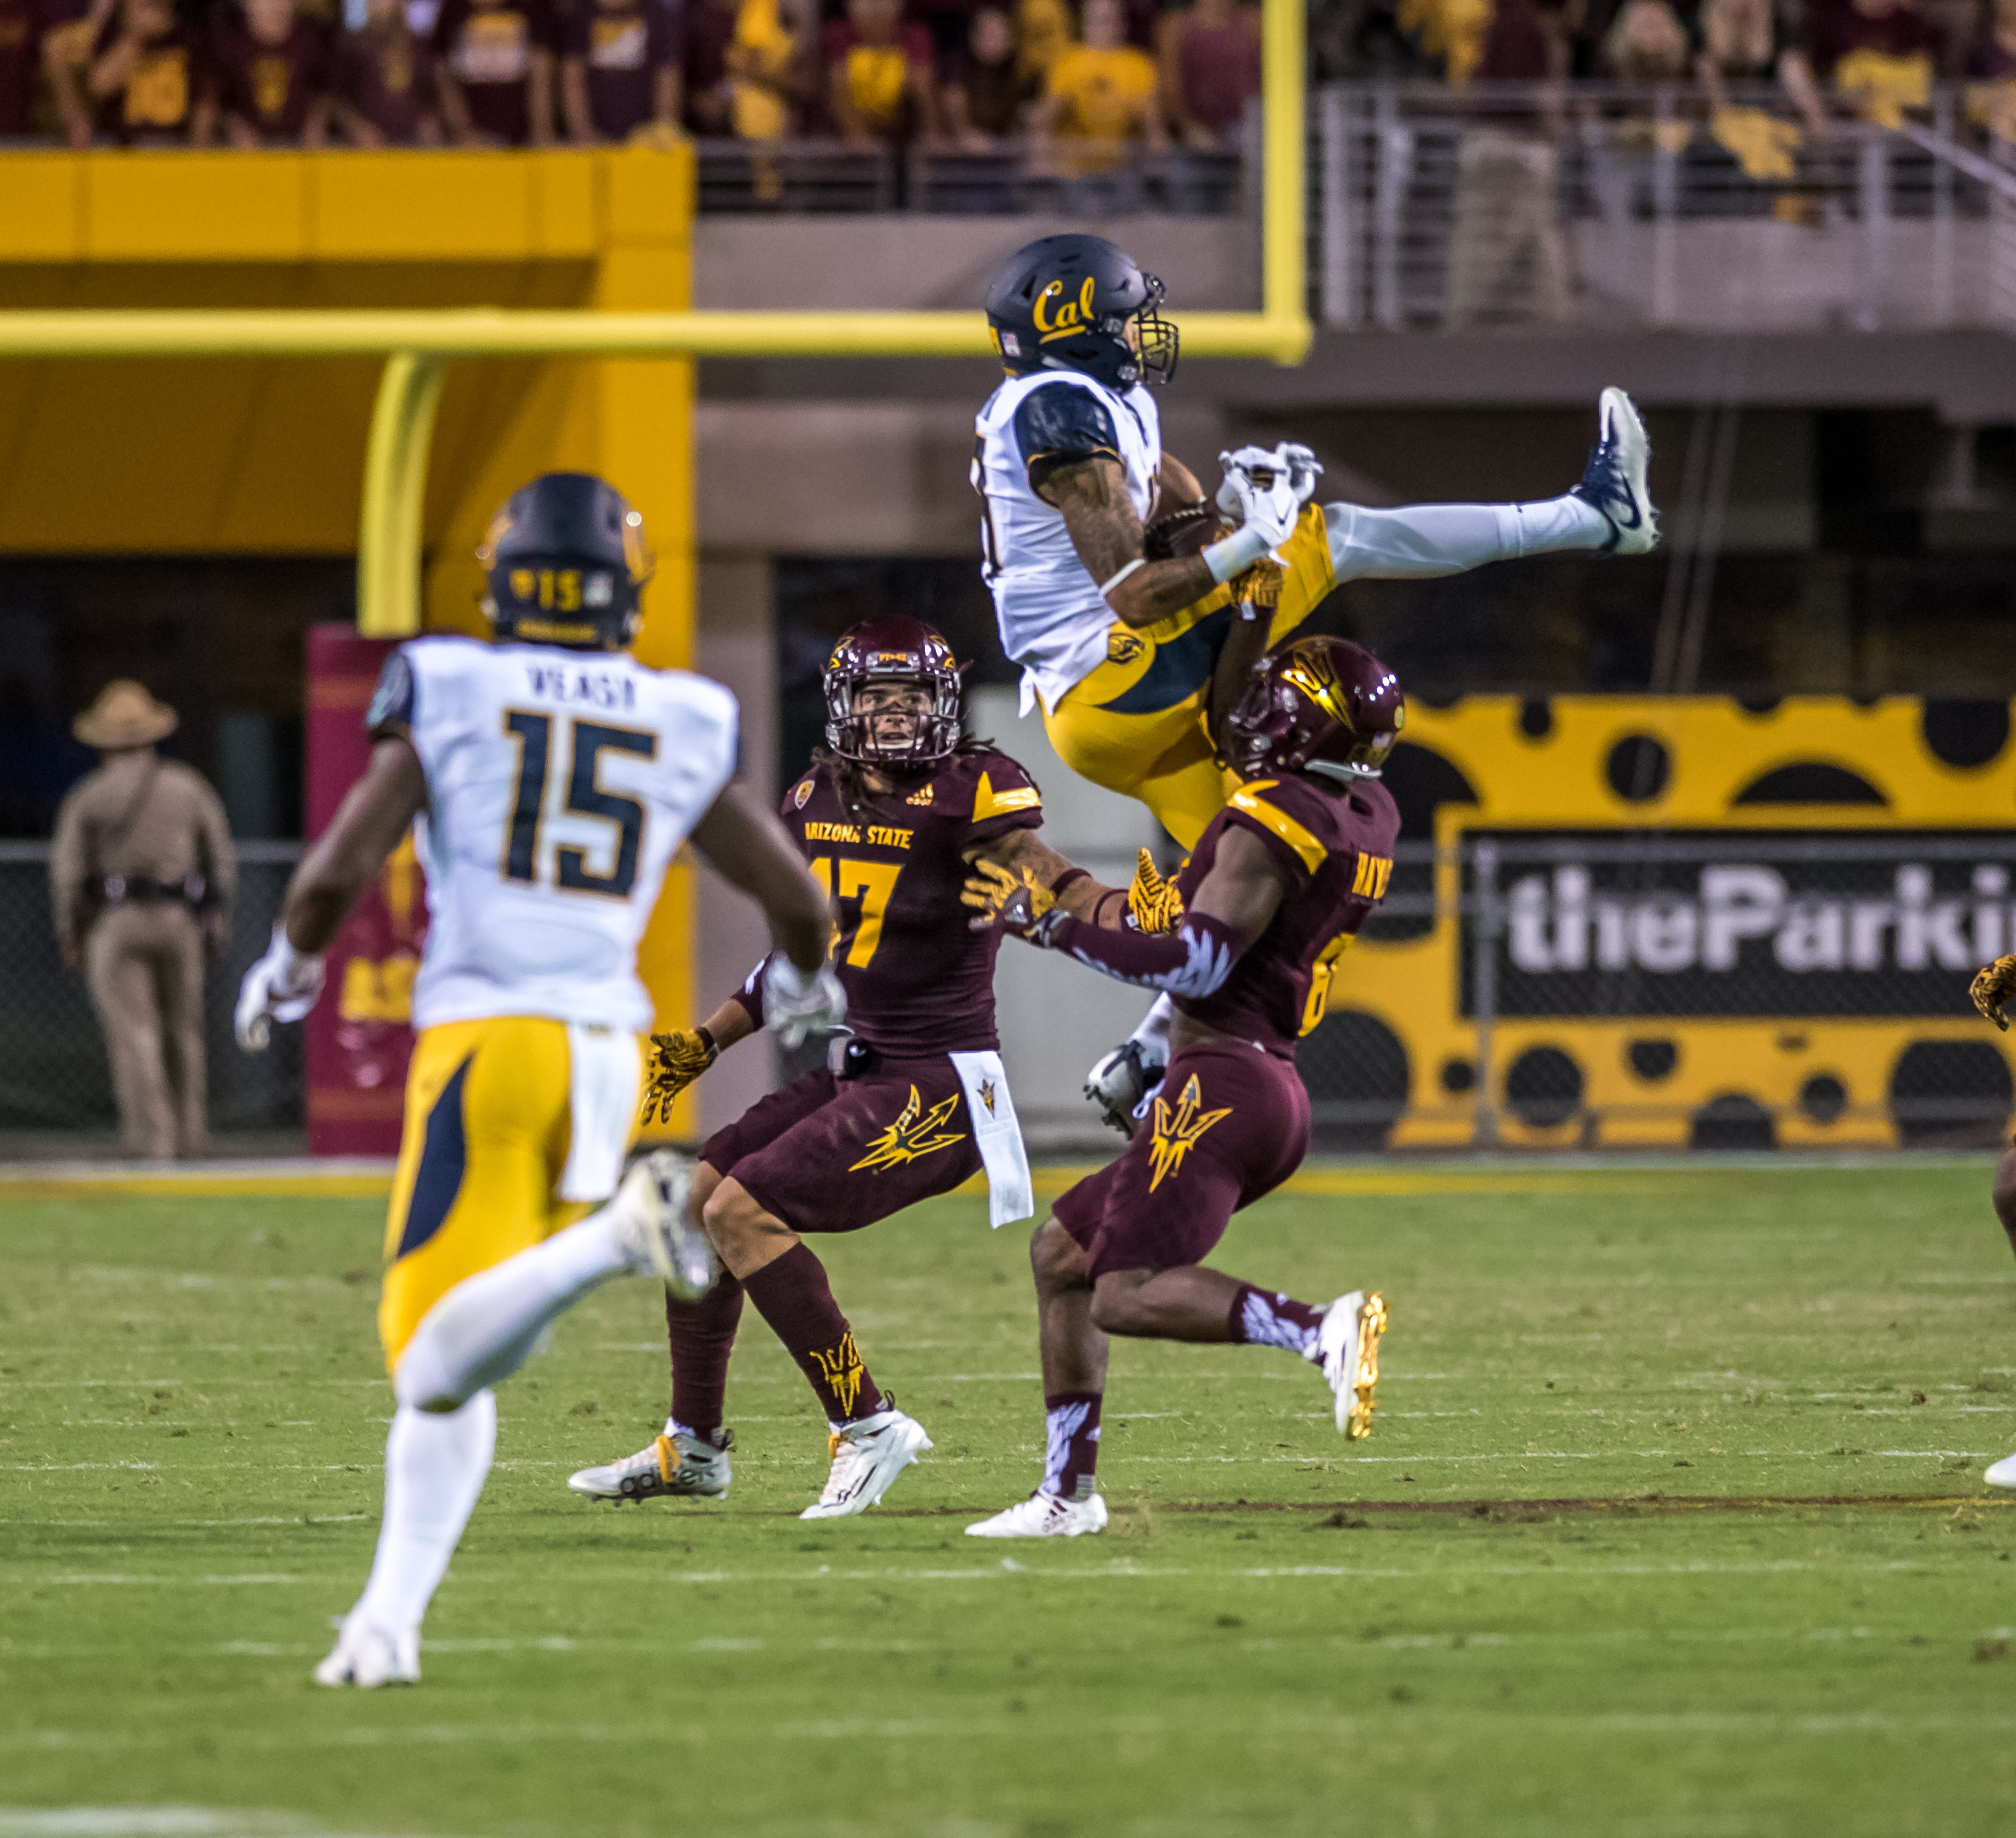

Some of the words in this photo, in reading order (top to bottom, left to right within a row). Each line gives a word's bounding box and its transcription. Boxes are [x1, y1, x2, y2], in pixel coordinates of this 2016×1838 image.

[1032, 275, 1095, 332] Cal
[501, 707, 658, 900] 15
[867, 824, 914, 850] STATE
[1508, 865, 2016, 972] theParki
